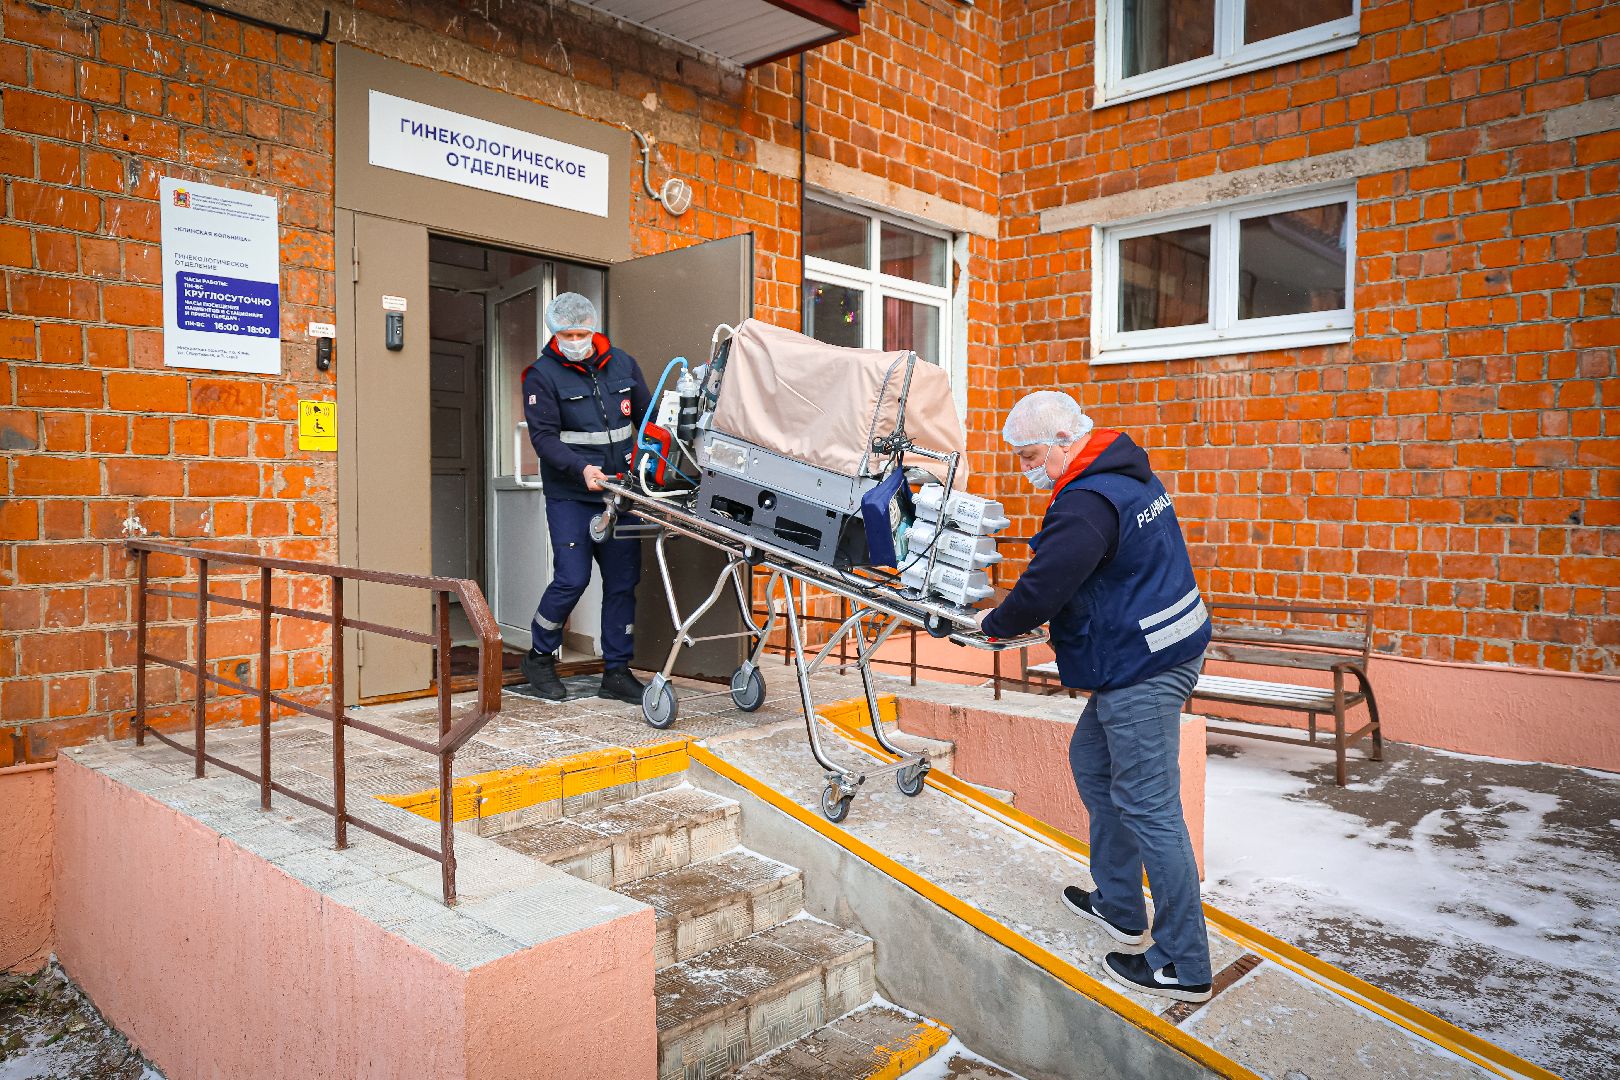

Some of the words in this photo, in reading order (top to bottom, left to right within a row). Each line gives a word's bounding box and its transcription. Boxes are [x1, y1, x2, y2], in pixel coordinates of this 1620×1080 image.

[400, 118, 586, 178] ГИНЕКОЛОГИЧЕСКОЕ
[446, 152, 549, 188] ОТДЕЛЕНИЕ
[174, 253, 249, 269] ГИНЕКОЛОГИЧЕСКОЕ
[174, 260, 217, 271] ОТДЕЛЕНИЕ
[184, 289, 272, 307] КРУГЛОСУТОЧНО
[214, 322, 239, 331] 16:00
[247, 325, 271, 335] 18:00
